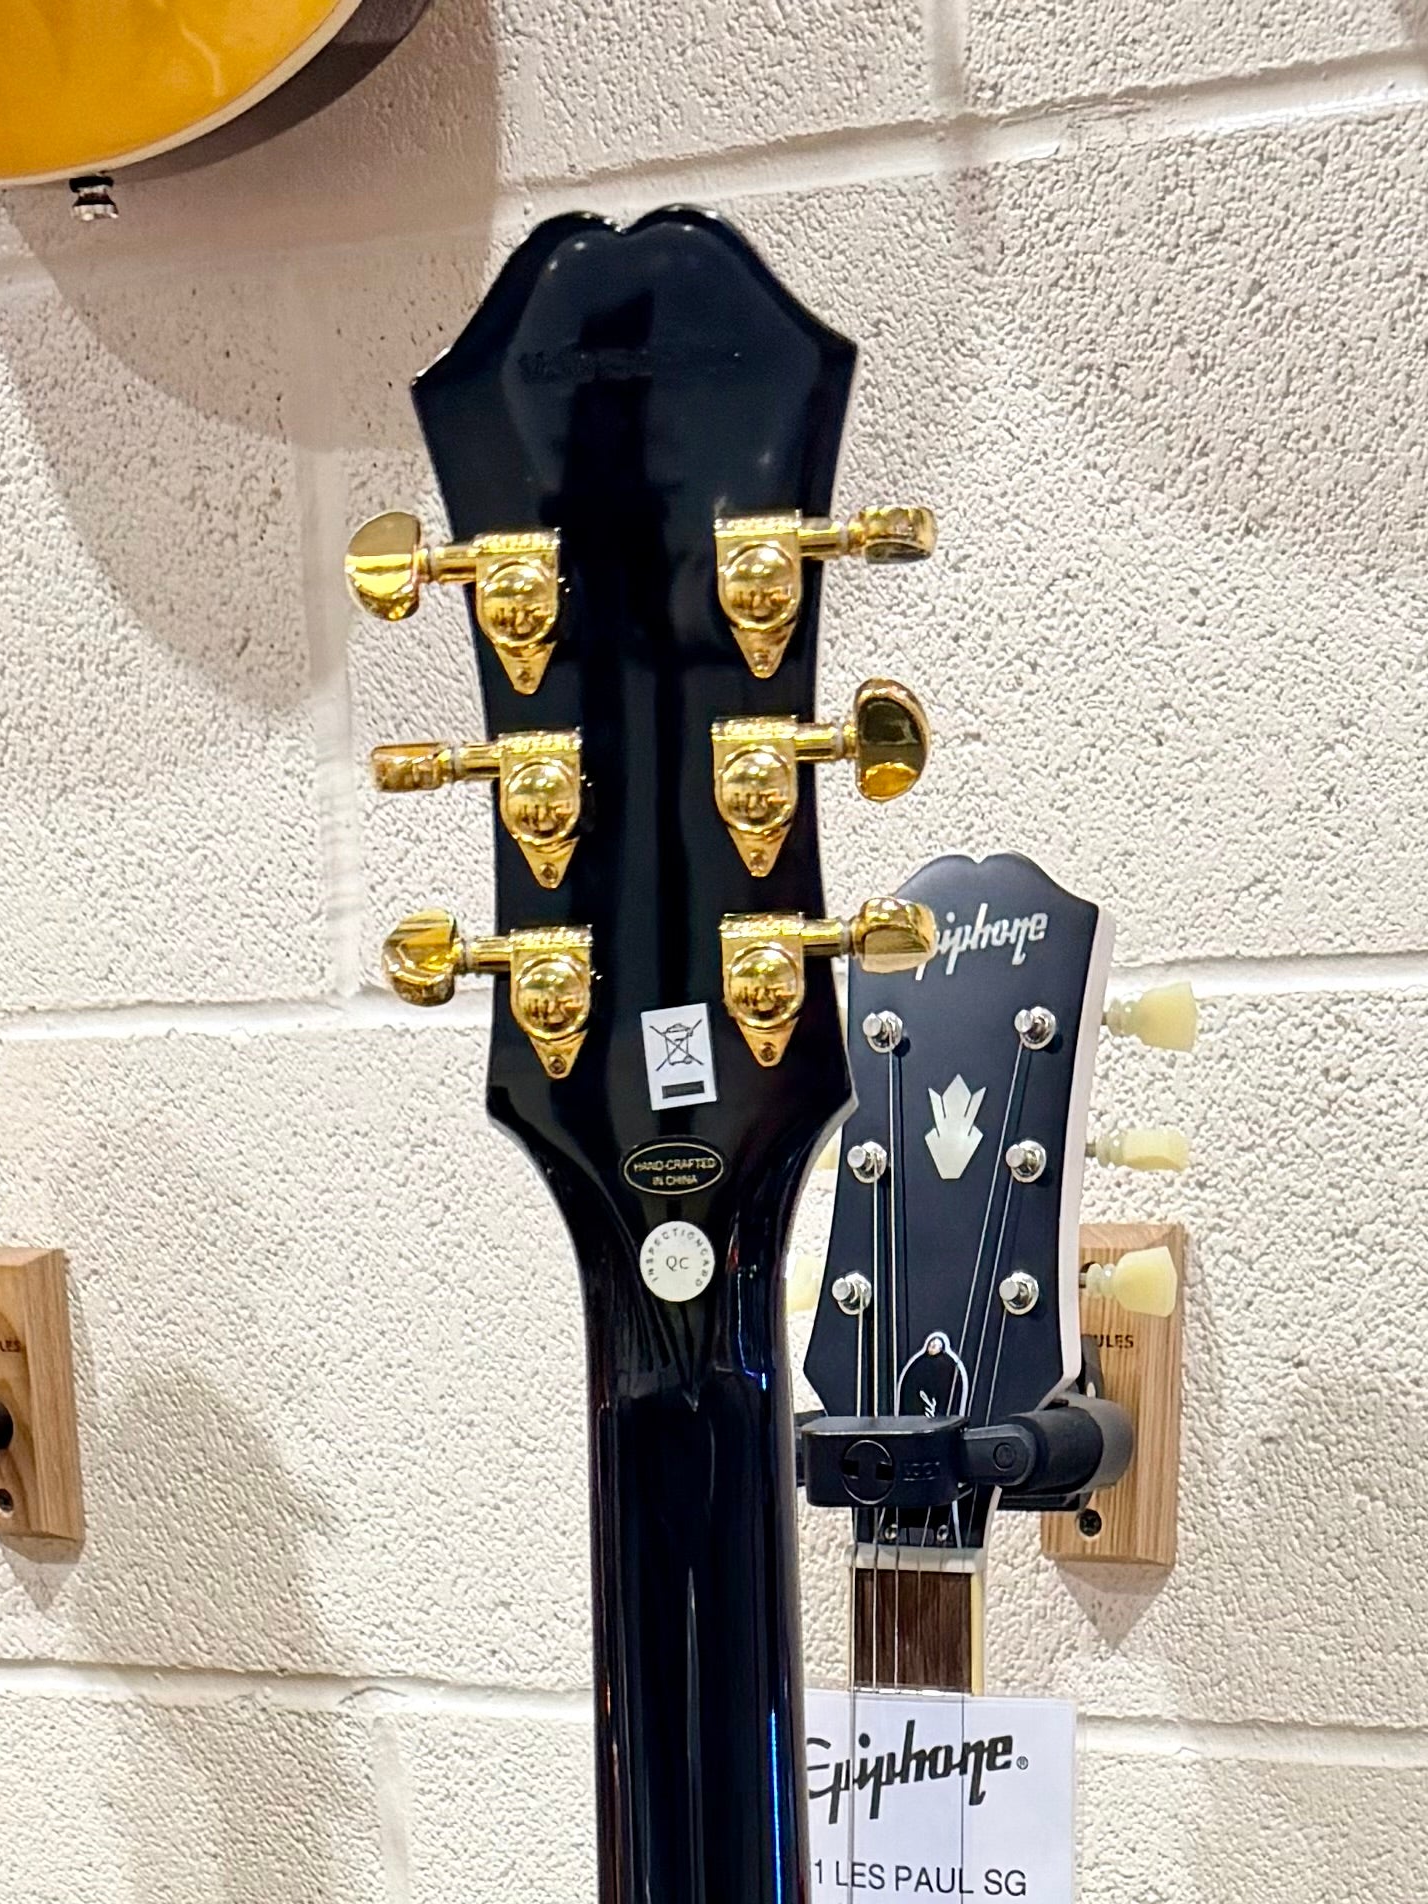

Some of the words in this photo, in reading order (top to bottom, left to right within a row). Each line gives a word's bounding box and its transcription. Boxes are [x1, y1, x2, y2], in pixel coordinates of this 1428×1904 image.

[915, 902, 1049, 981] iphone
[665, 1174, 699, 1187] CHINA
[666, 1255, 691, 1273] QC
[806, 1719, 1014, 1825] Epiphone
[835, 1861, 886, 1892] LES
[895, 1864, 974, 1896] PAUL
[983, 1868, 1028, 1898] SG
